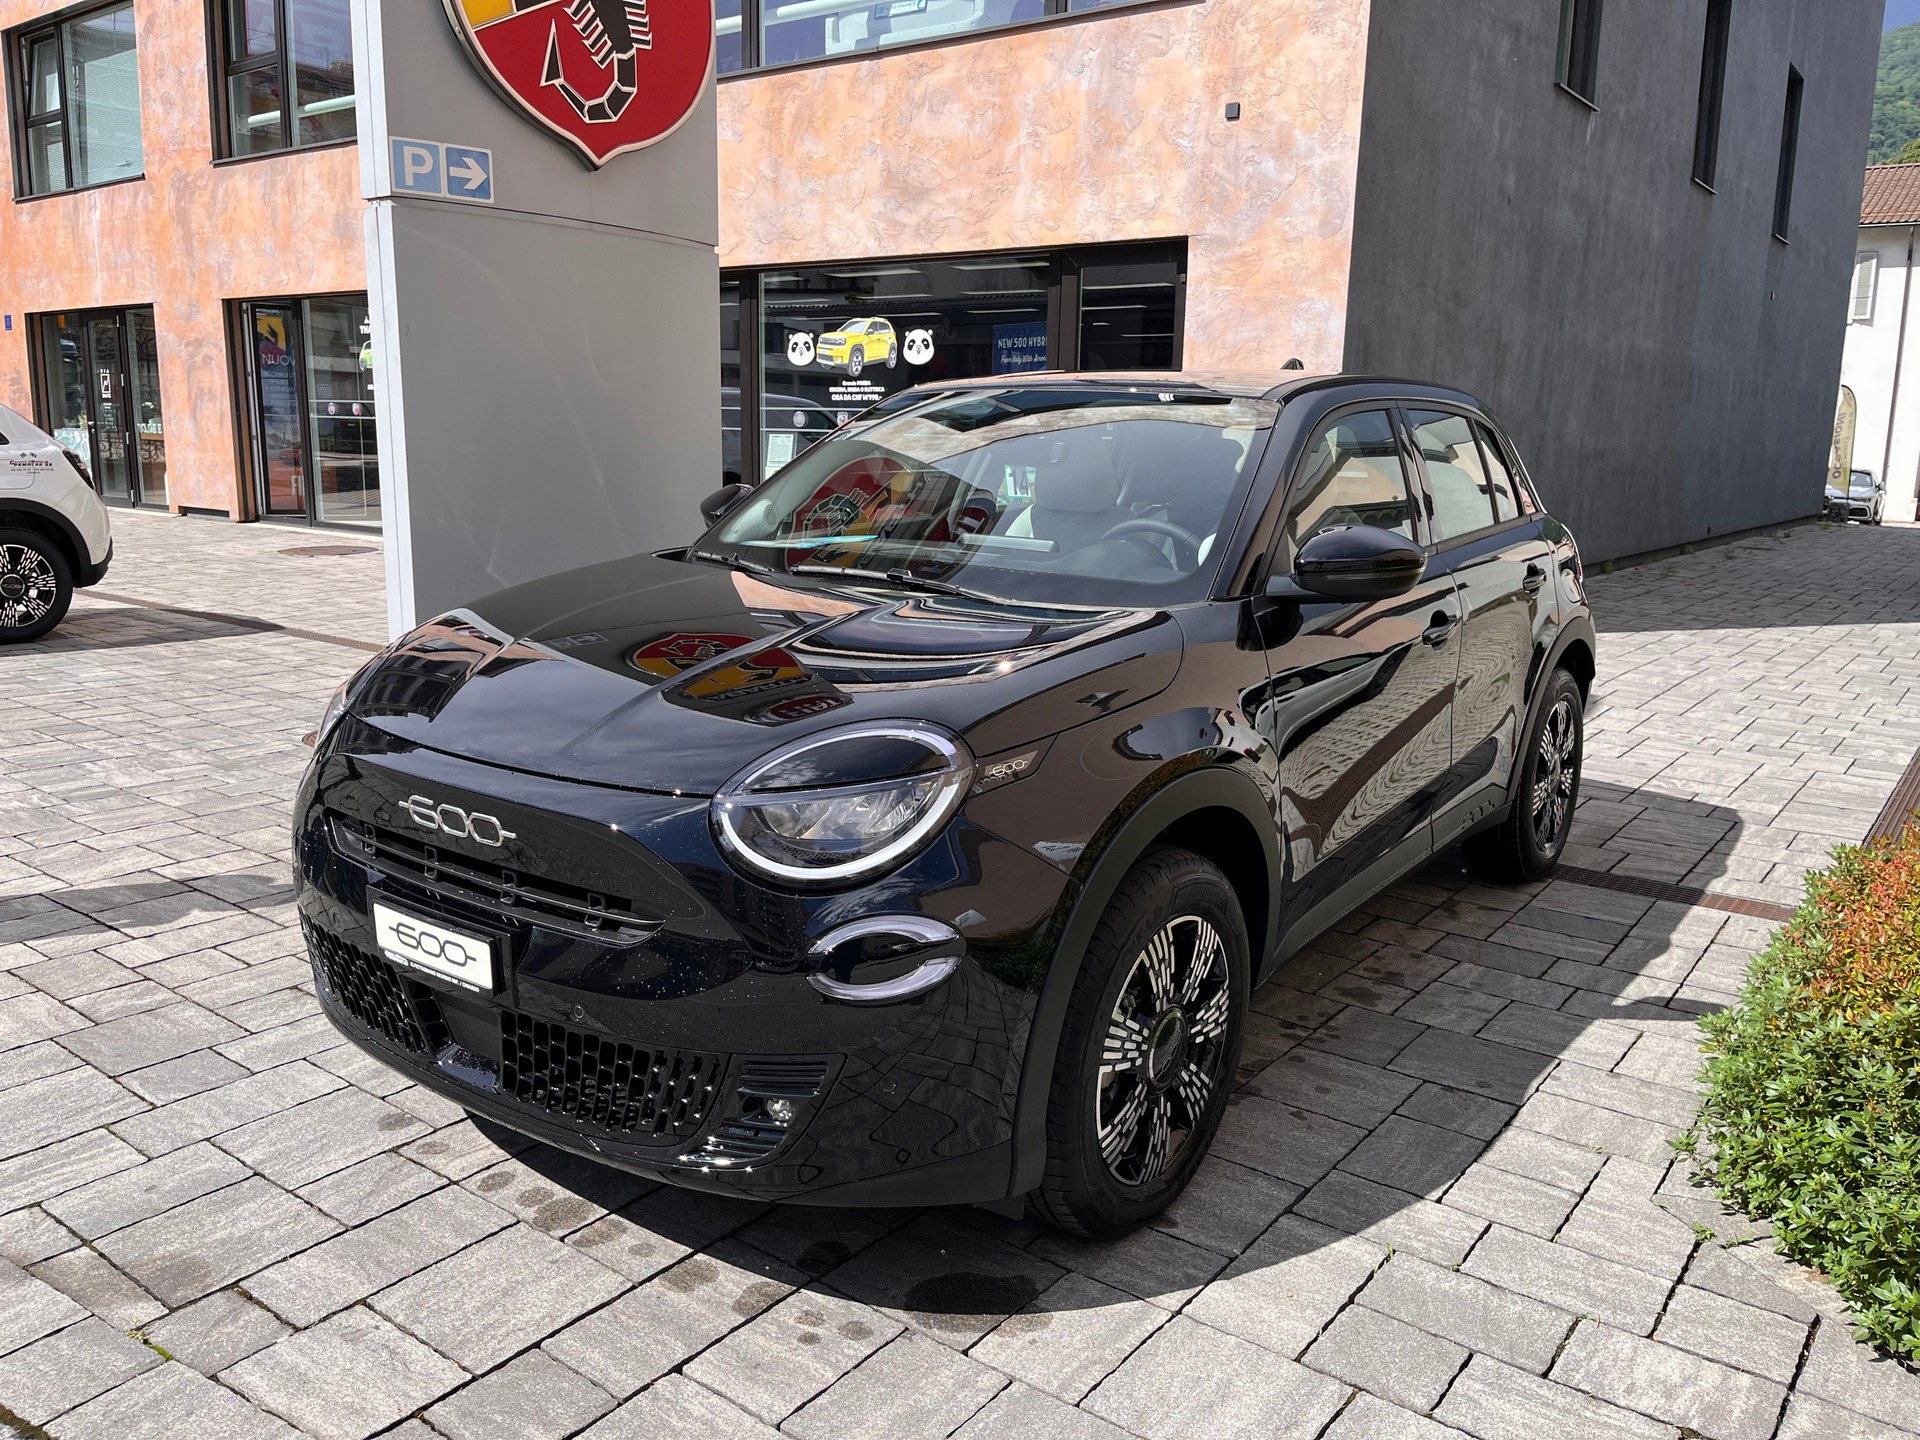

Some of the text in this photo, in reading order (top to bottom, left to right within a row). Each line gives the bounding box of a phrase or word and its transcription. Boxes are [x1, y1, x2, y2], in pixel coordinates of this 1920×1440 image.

[403, 145, 434, 187] P
[998, 338, 1013, 349] NEW
[1014, 337, 1027, 348] 500
[398, 794, 518, 848] 600
[388, 921, 477, 968] 600
